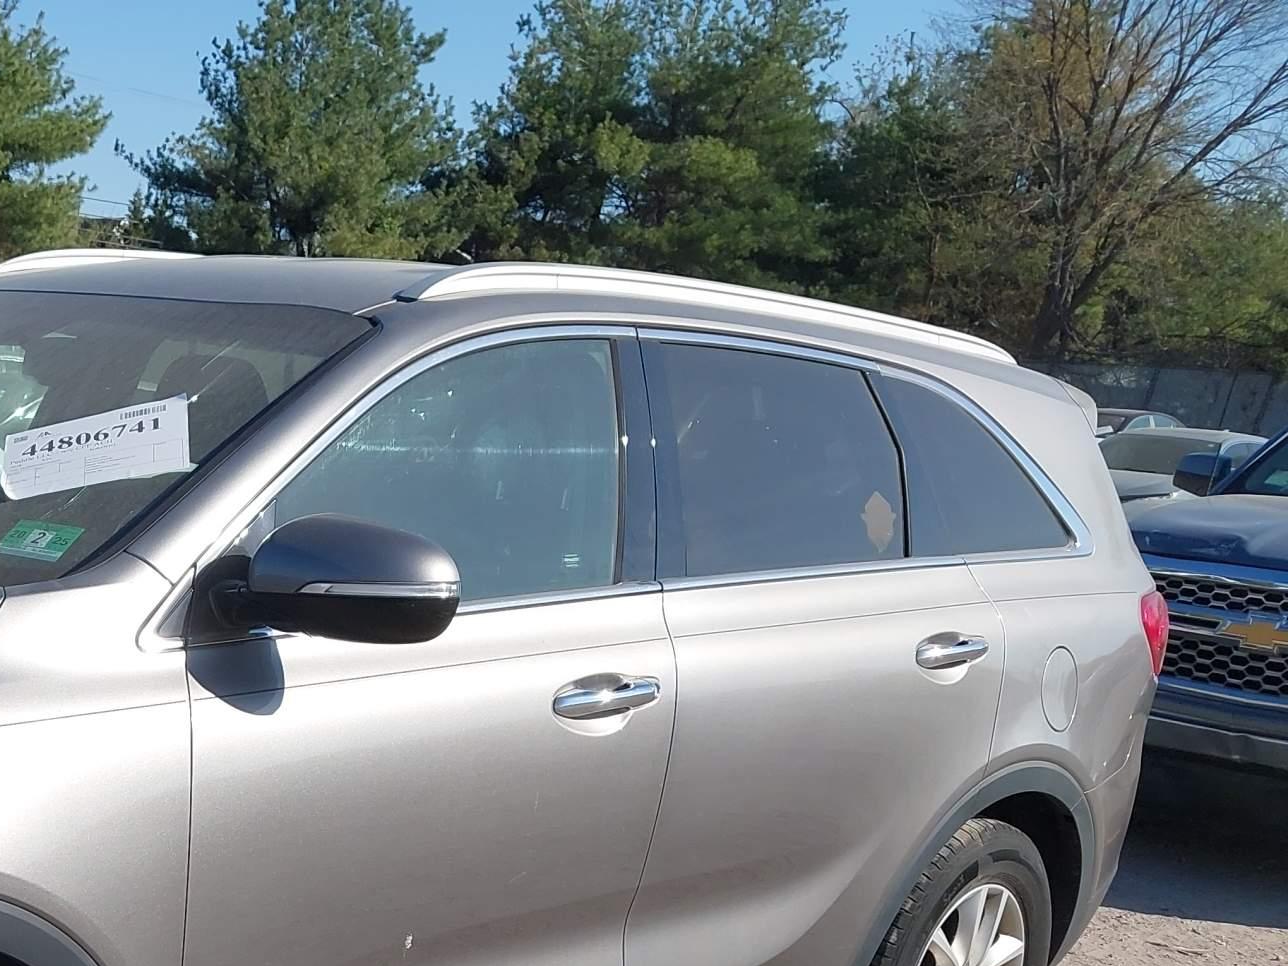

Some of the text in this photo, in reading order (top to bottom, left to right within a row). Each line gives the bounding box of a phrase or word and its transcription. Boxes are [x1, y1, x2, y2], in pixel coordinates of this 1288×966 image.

[21, 417, 161, 457] 44806741
[32, 532, 47, 544] 2
[53, 536, 69, 546] 25
